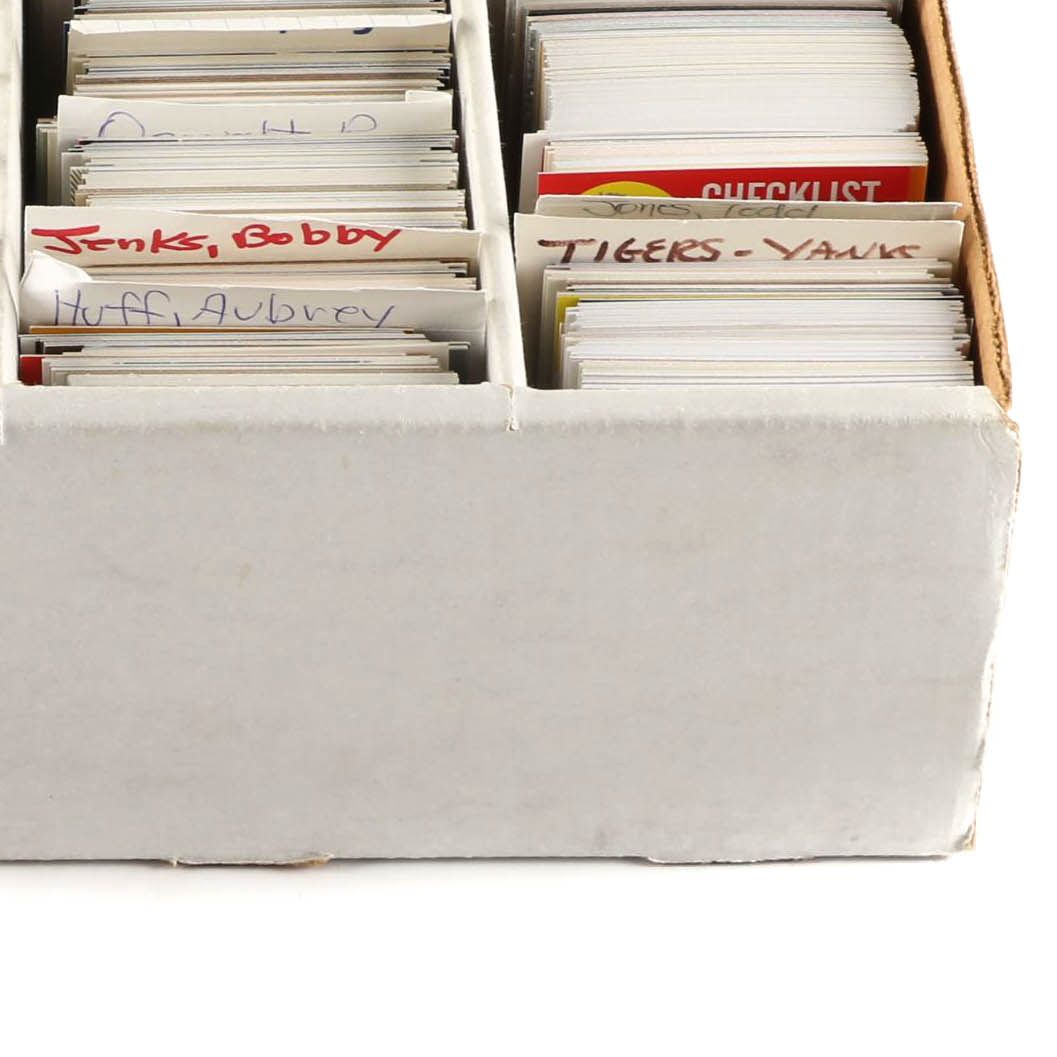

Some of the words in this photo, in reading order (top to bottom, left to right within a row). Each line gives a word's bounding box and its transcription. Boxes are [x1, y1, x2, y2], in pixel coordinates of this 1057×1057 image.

[31, 224, 220, 259] Jenks,
[231, 222, 402, 253] Bobby
[537, 238, 725, 265] TIGERS
[52, 289, 182, 328] Huff,
[192, 291, 397, 329] Aubrey
